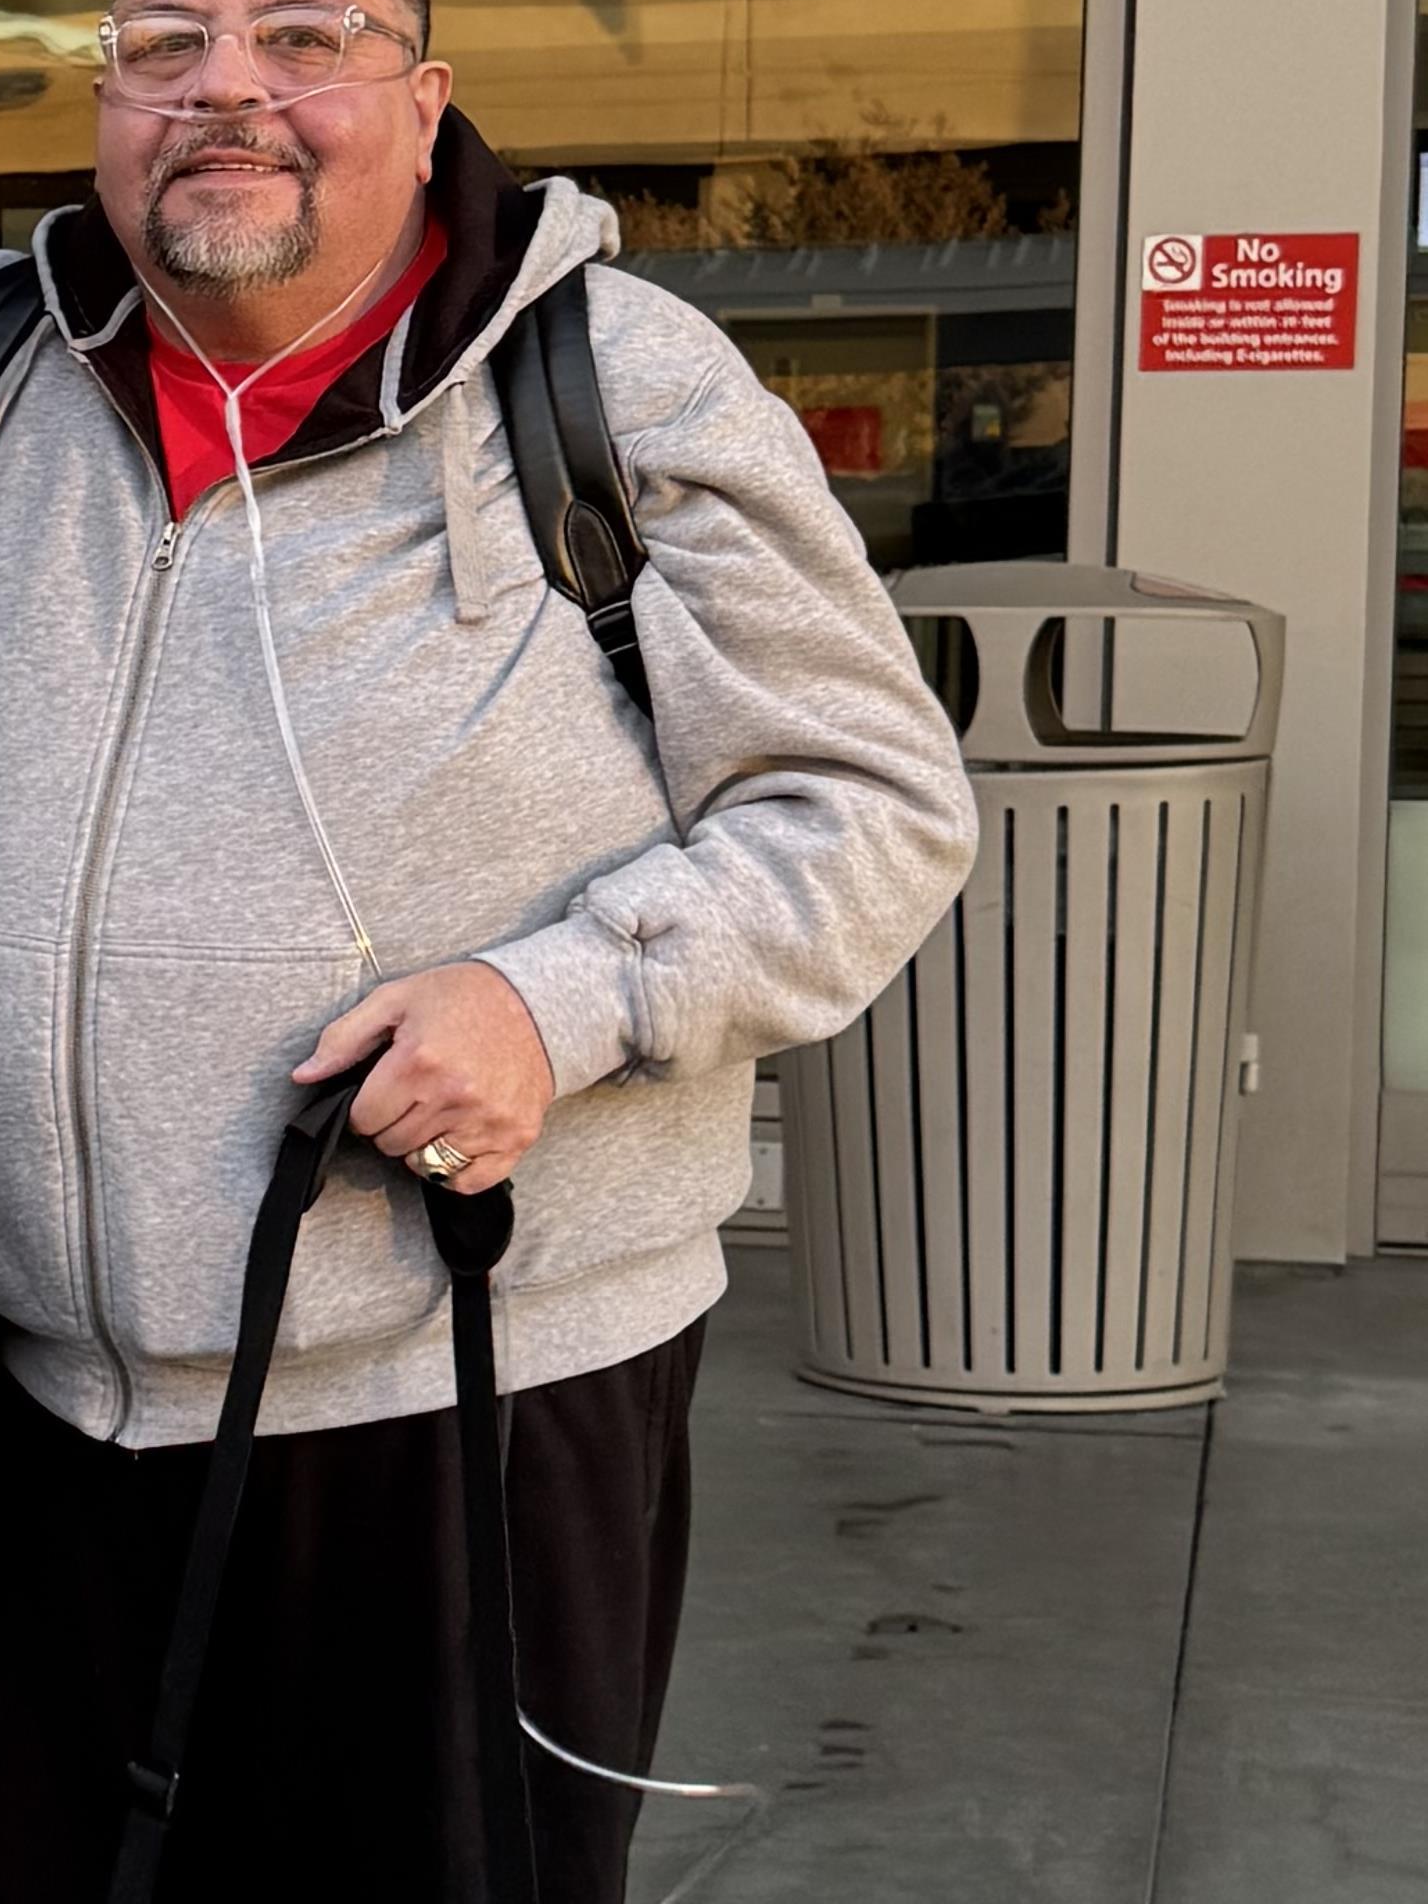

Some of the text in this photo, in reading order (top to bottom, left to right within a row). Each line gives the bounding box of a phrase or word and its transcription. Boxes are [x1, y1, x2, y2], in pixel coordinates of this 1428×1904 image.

[1237, 239, 1280, 262] No
[1211, 263, 1343, 294] Smoking
[1163, 299, 1226, 314] Smoking
[1152, 332, 1169, 346] of
[1172, 332, 1198, 346] the
